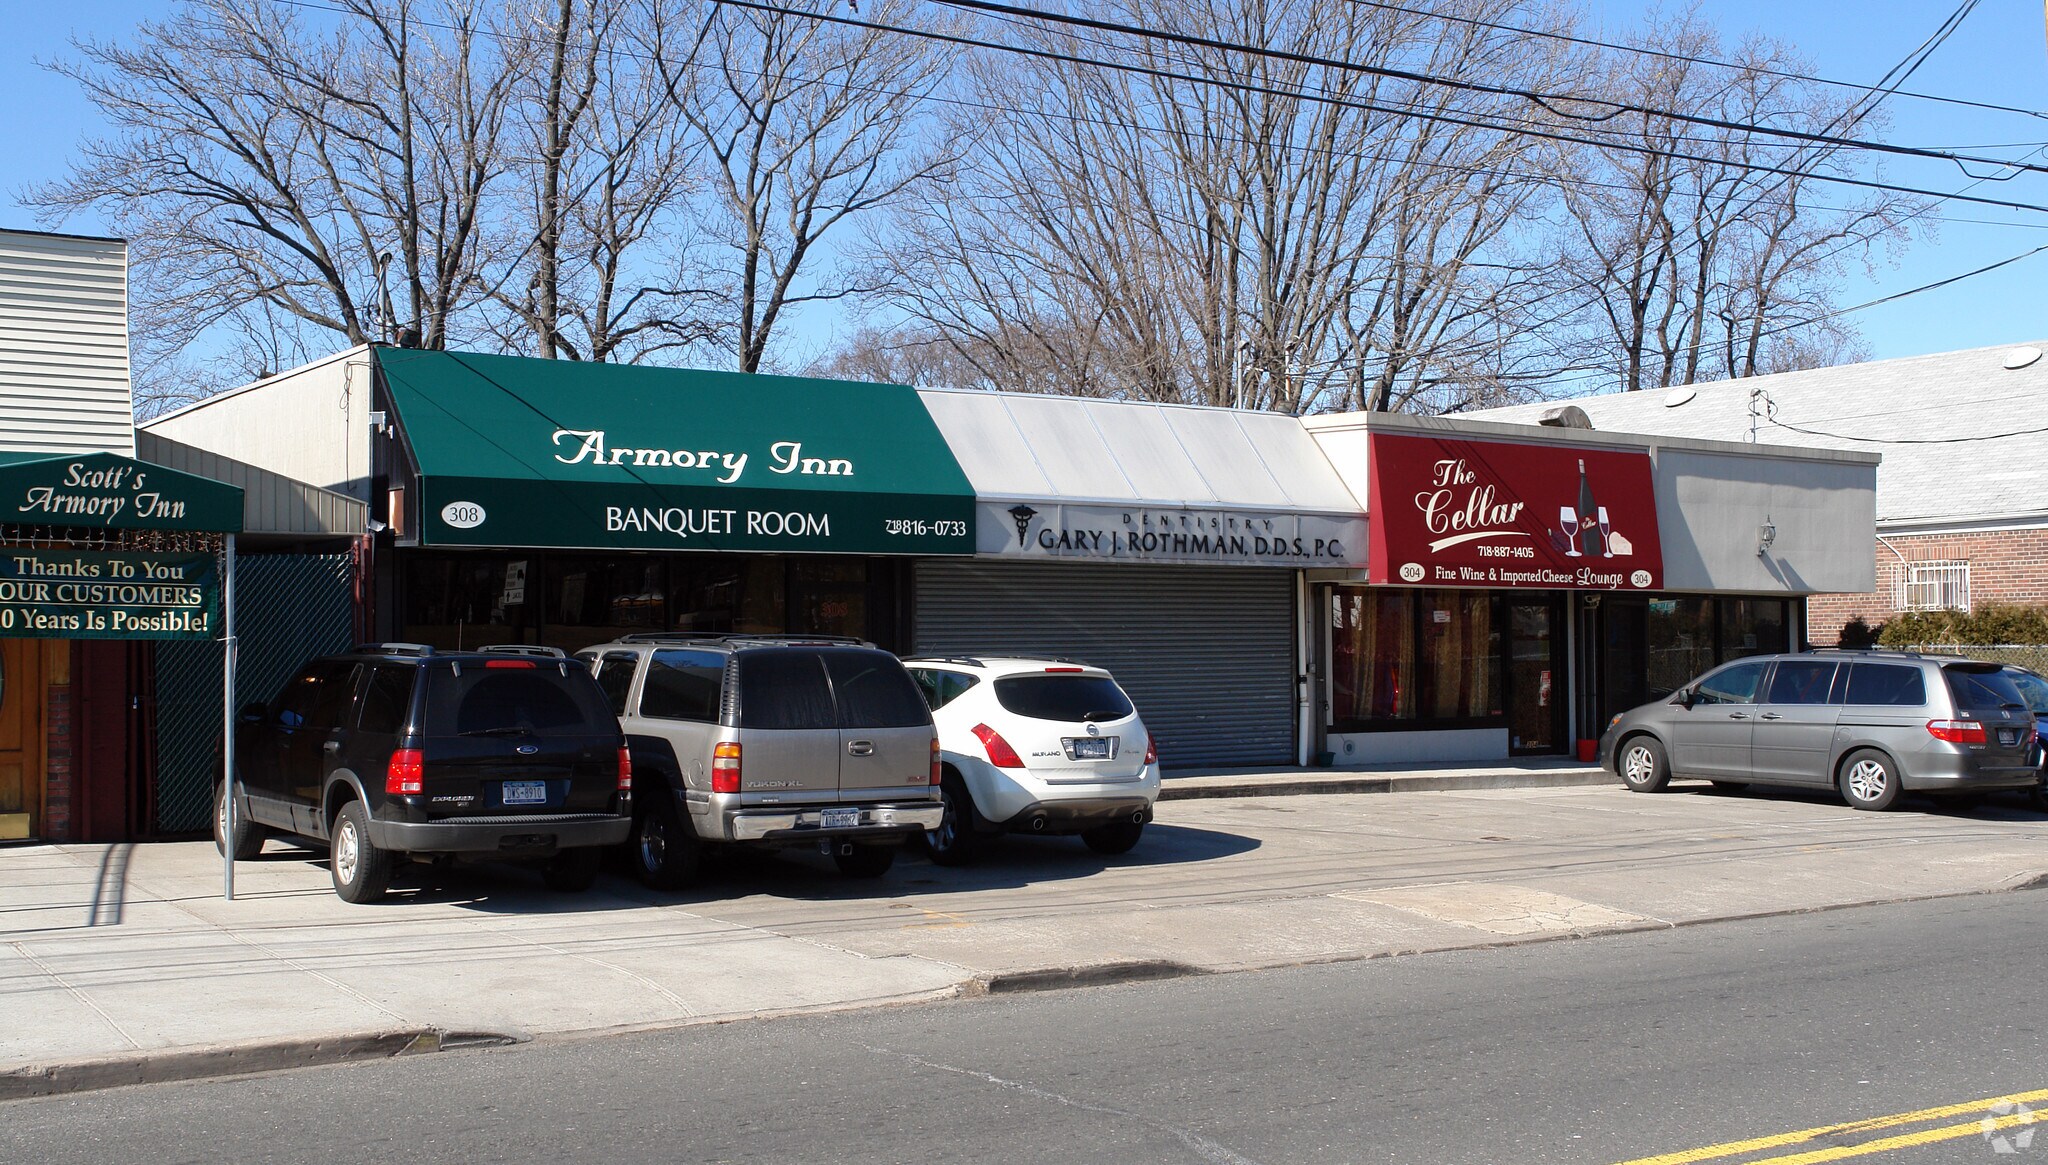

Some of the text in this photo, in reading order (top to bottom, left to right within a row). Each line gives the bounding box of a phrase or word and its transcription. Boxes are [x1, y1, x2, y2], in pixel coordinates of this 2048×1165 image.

[552, 427, 854, 484] Armory Inn
[63, 462, 147, 490] Scott's
[1432, 458, 1476, 487] The
[18, 486, 186, 525] Armory Inn
[449, 506, 478, 522] 308
[1414, 484, 1524, 534] Cellar
[606, 506, 831, 539] BANQUET ROOM
[1123, 513, 1271, 530] DENTISTRY
[1038, 528, 1104, 551] GARY
[1112, 530, 1122, 556] J.
[1128, 531, 1249, 557] ROTHMAN,
[1313, 538, 1344, 558] P.C.
[13, 556, 185, 580] Thanks To You
[1403, 566, 1421, 579] 304
[1435, 566, 1457, 580] Fine
[1460, 567, 1485, 581] Wine
[1488, 568, 1498, 581] &
[1576, 566, 1624, 590] Lounge
[1634, 573, 1650, 585] 304
[0, 582, 202, 605] OUR CUSTOMERS
[21, 608, 80, 630] Years
[86, 610, 106, 631] Is
[111, 610, 209, 632] Possible!
